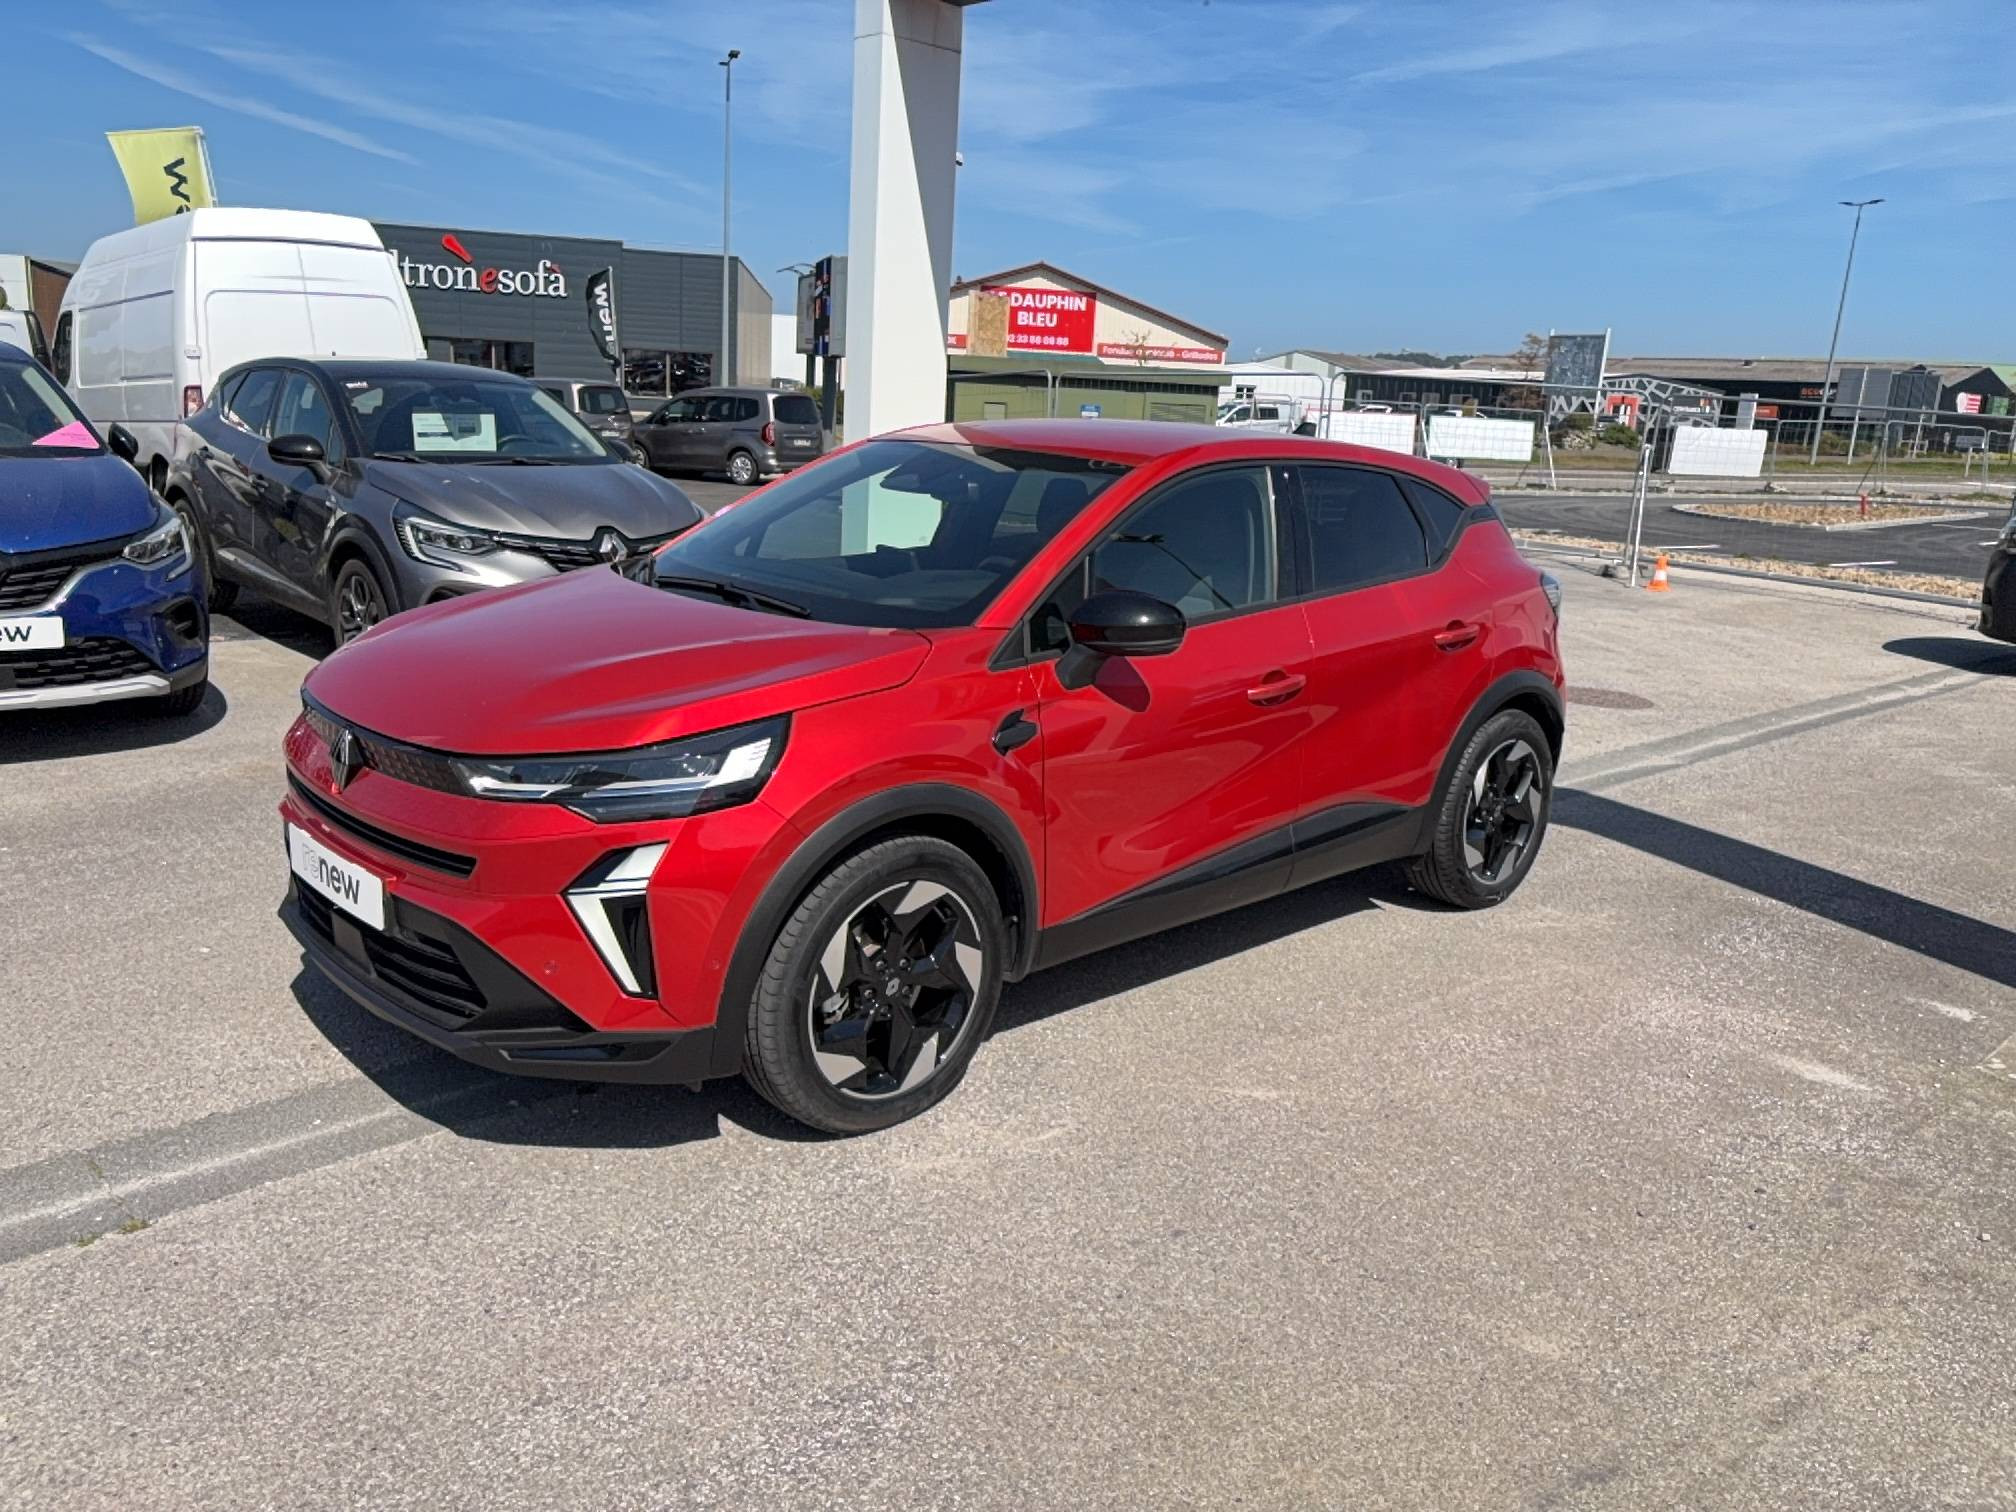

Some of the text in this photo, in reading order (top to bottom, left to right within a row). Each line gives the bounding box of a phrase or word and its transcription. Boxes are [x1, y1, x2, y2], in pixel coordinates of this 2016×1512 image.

[1011, 293, 1087, 312] DAUPHIN
[1017, 311, 1058, 328] BLEU
[302, 842, 361, 905] renew
